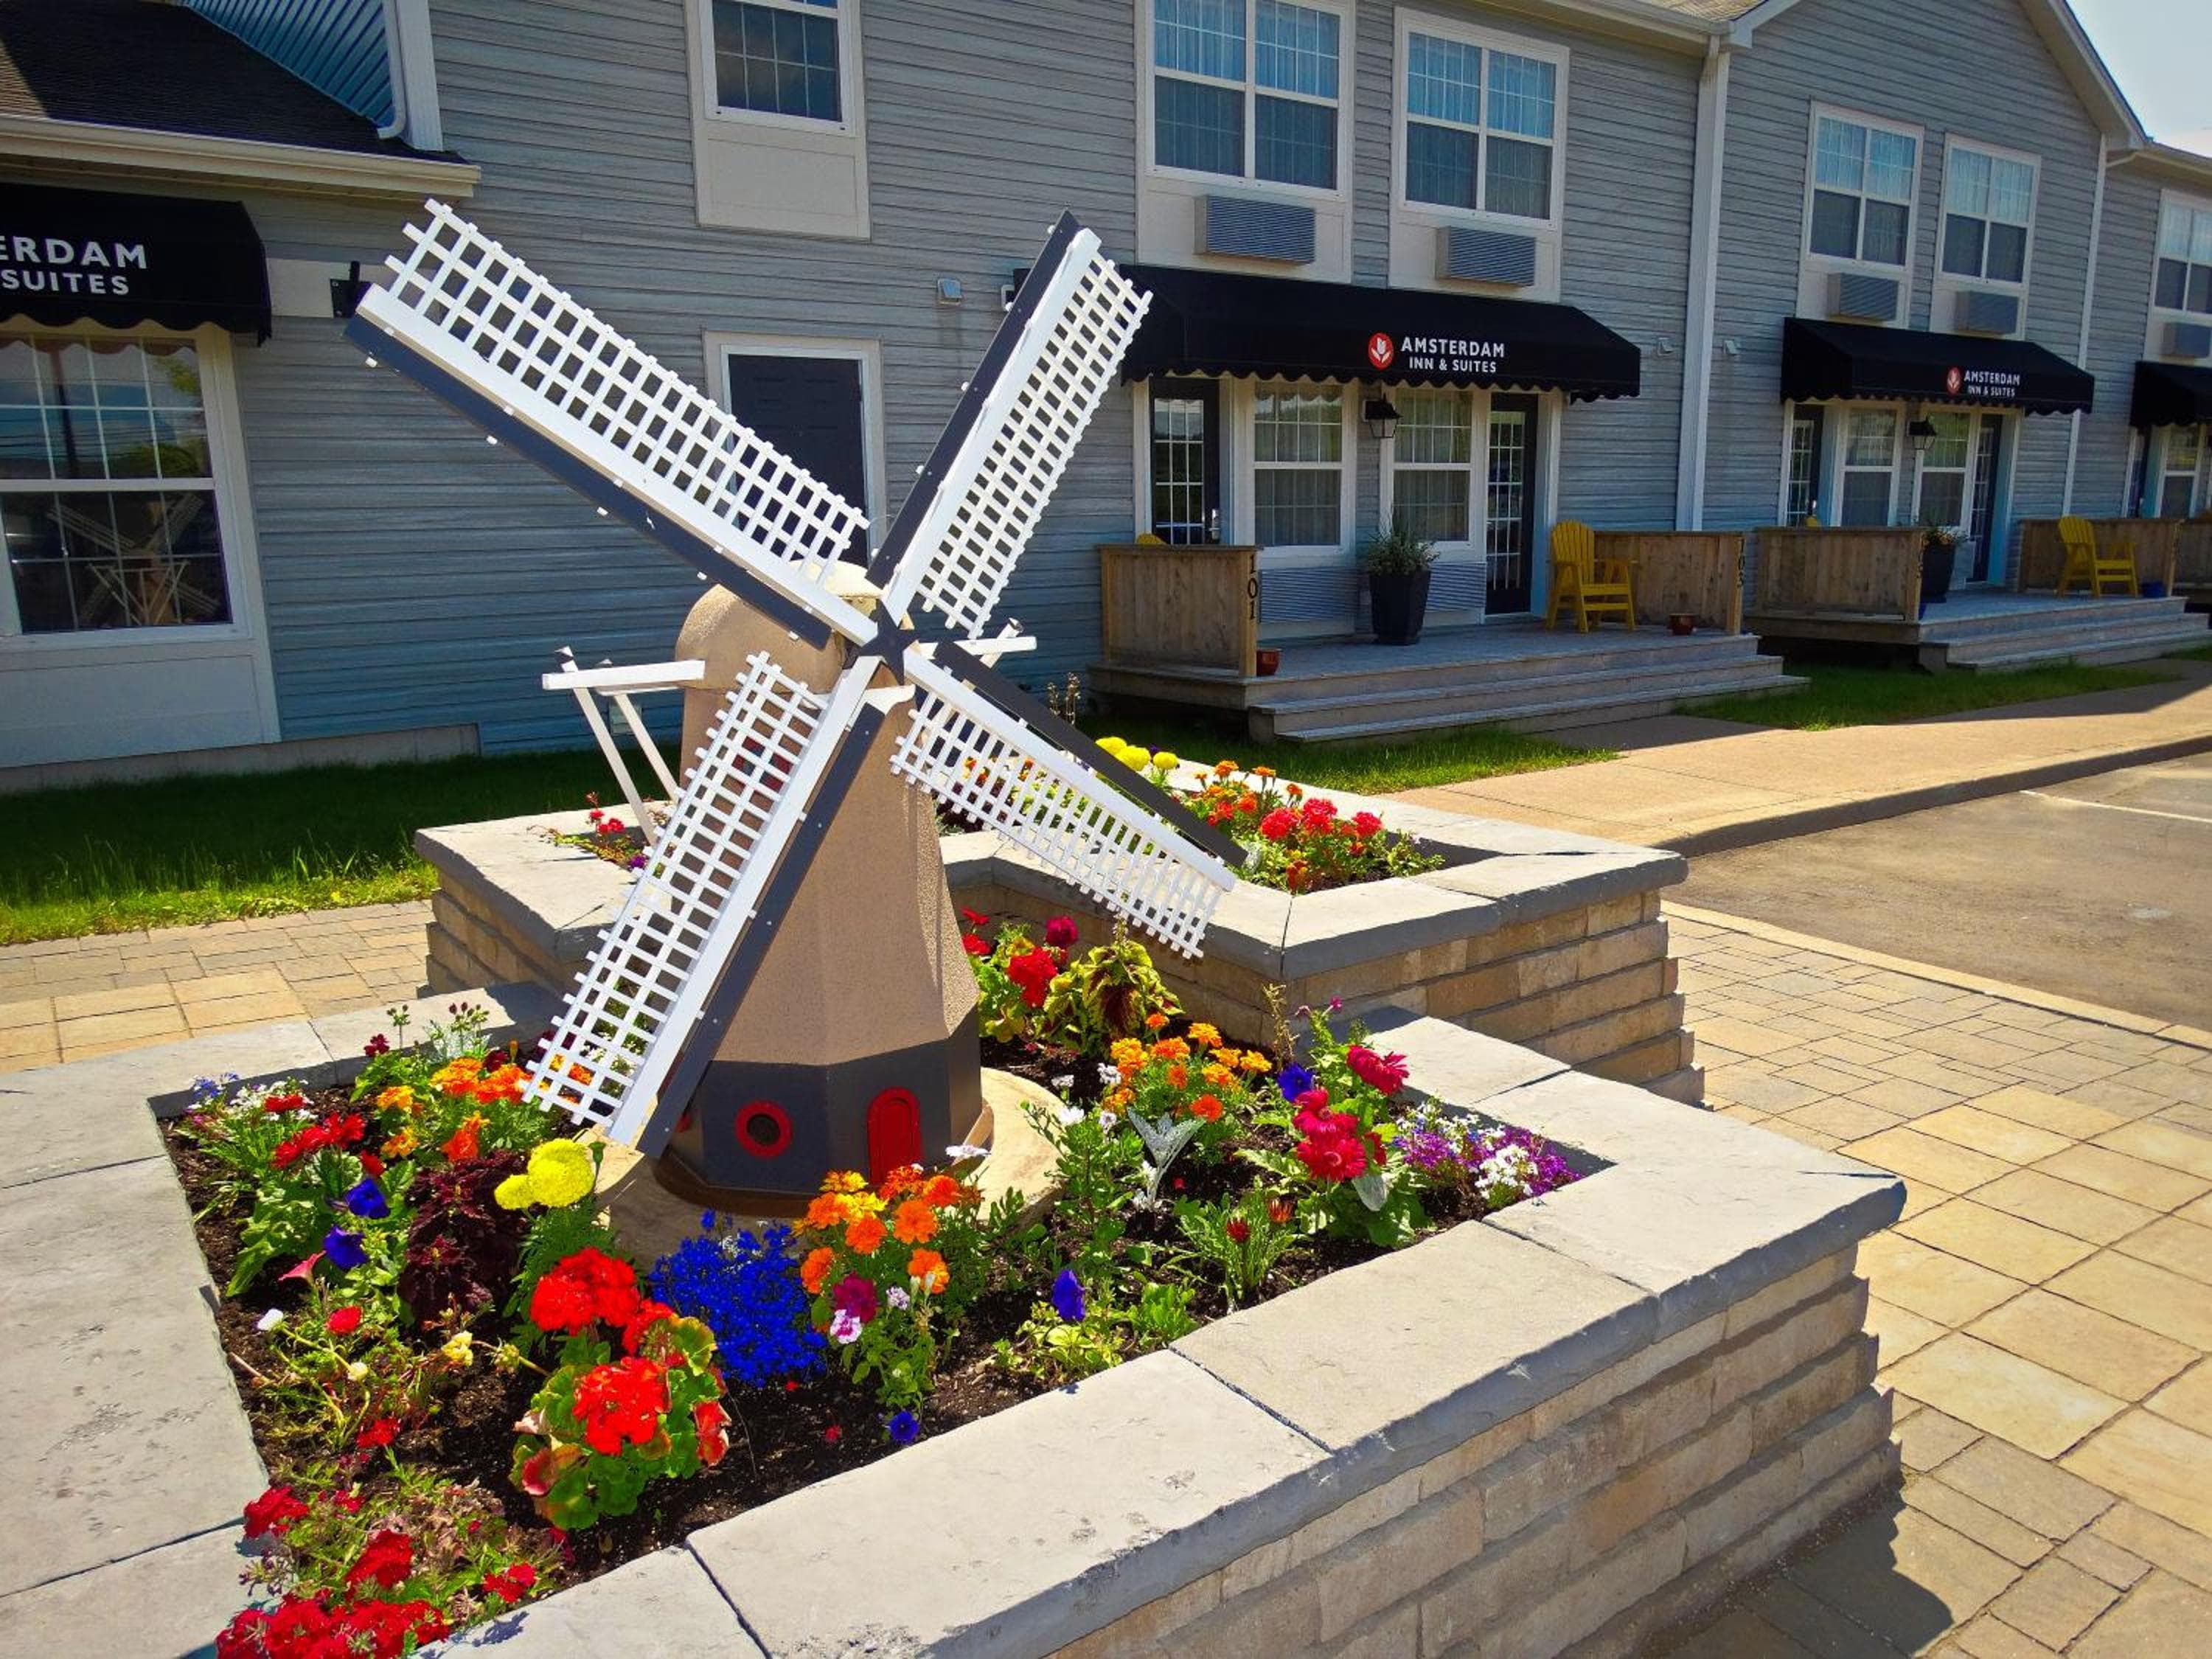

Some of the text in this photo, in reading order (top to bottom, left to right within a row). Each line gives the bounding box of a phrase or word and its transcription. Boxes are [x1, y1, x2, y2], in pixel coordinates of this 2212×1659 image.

[1, 269, 129, 295] SUITES
[1401, 336, 1505, 358] AMSTERDAM
[1409, 356, 1496, 373] INN & SUITES
[1964, 369, 2020, 386] AMSTERDAM
[1968, 384, 2016, 397] INN & SUITES
[1248, 554, 1258, 620] 101
